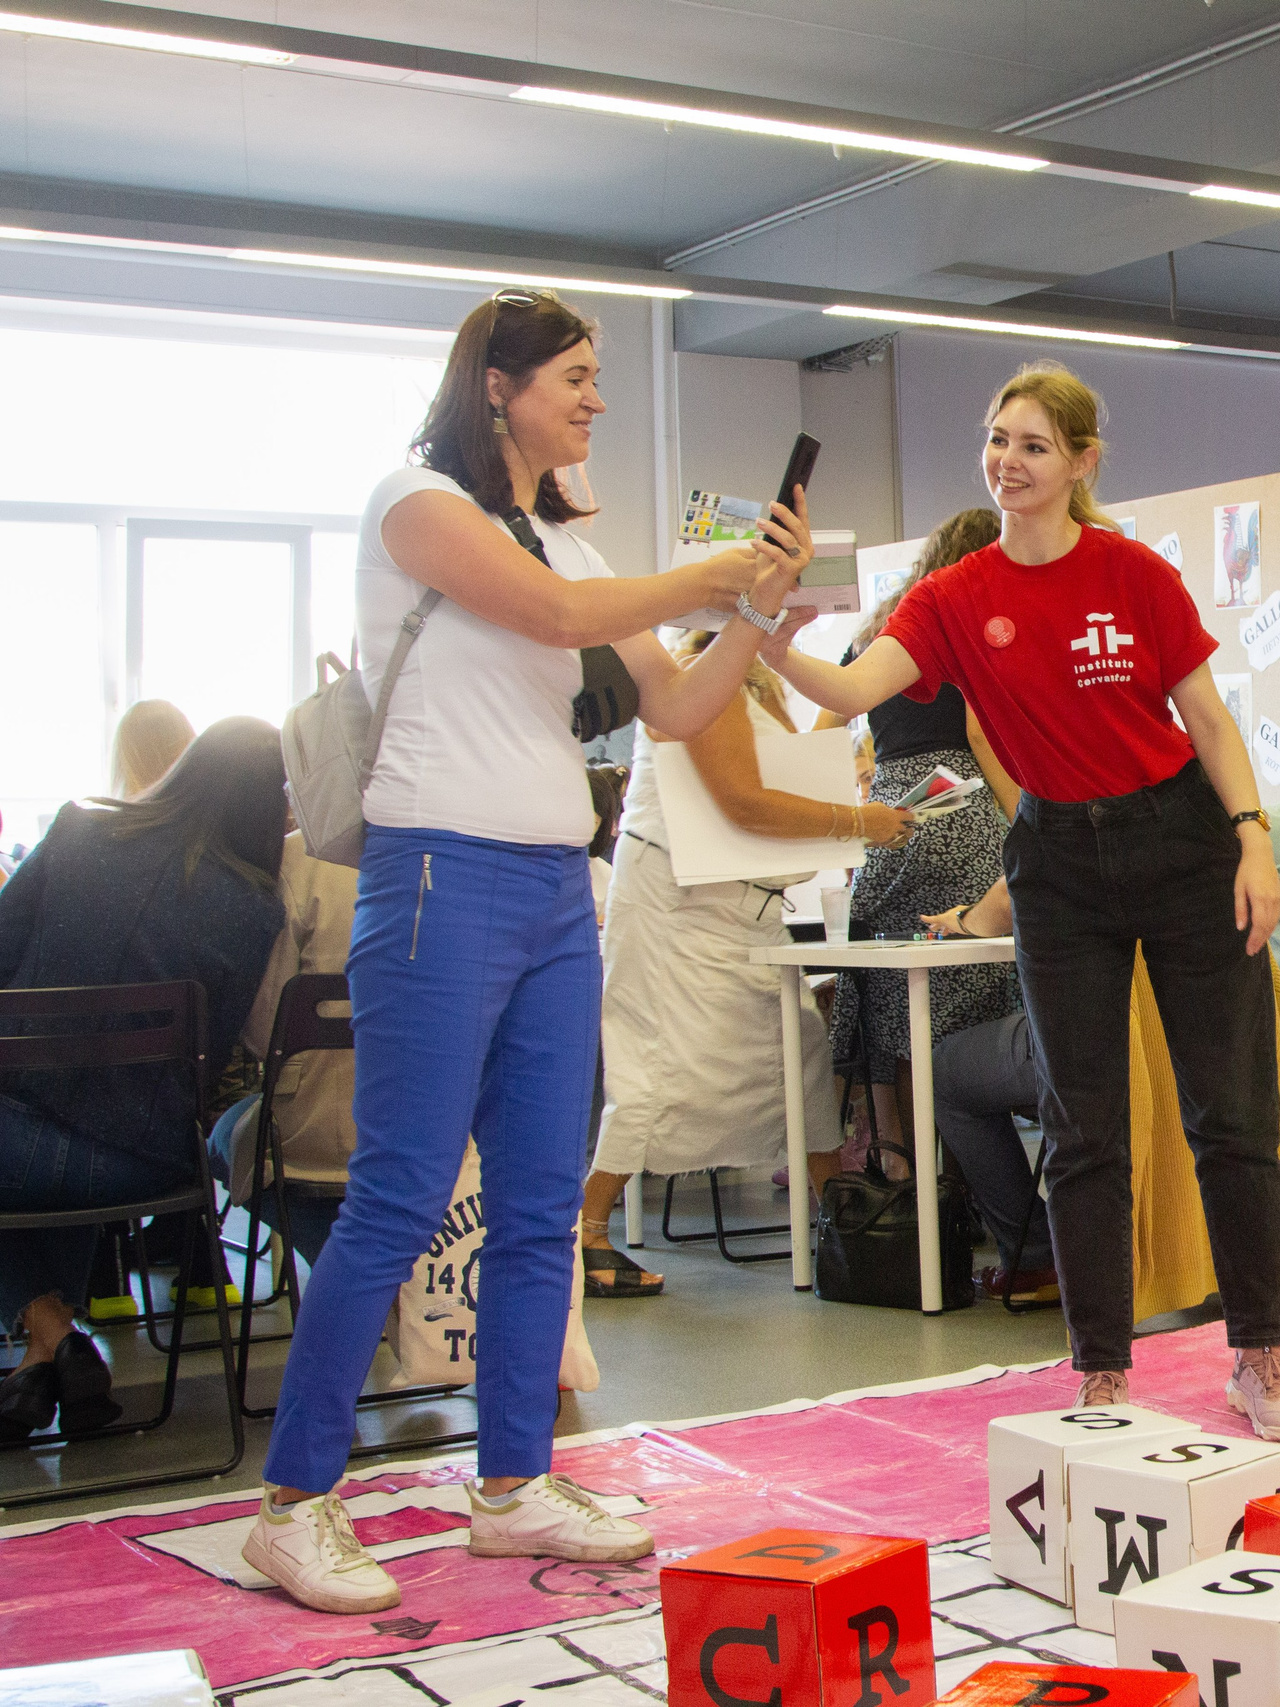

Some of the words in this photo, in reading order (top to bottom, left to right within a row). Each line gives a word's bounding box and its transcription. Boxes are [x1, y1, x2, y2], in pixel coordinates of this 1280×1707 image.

[1074, 659, 1134, 674] Instituto
[426, 1263, 456, 1294] 14
[1060, 1412, 1133, 1430] S
[1142, 1443, 1230, 1463] S
[734, 1543, 841, 1566] D
[699, 1614, 783, 1707] C
[847, 1605, 911, 1707] R
